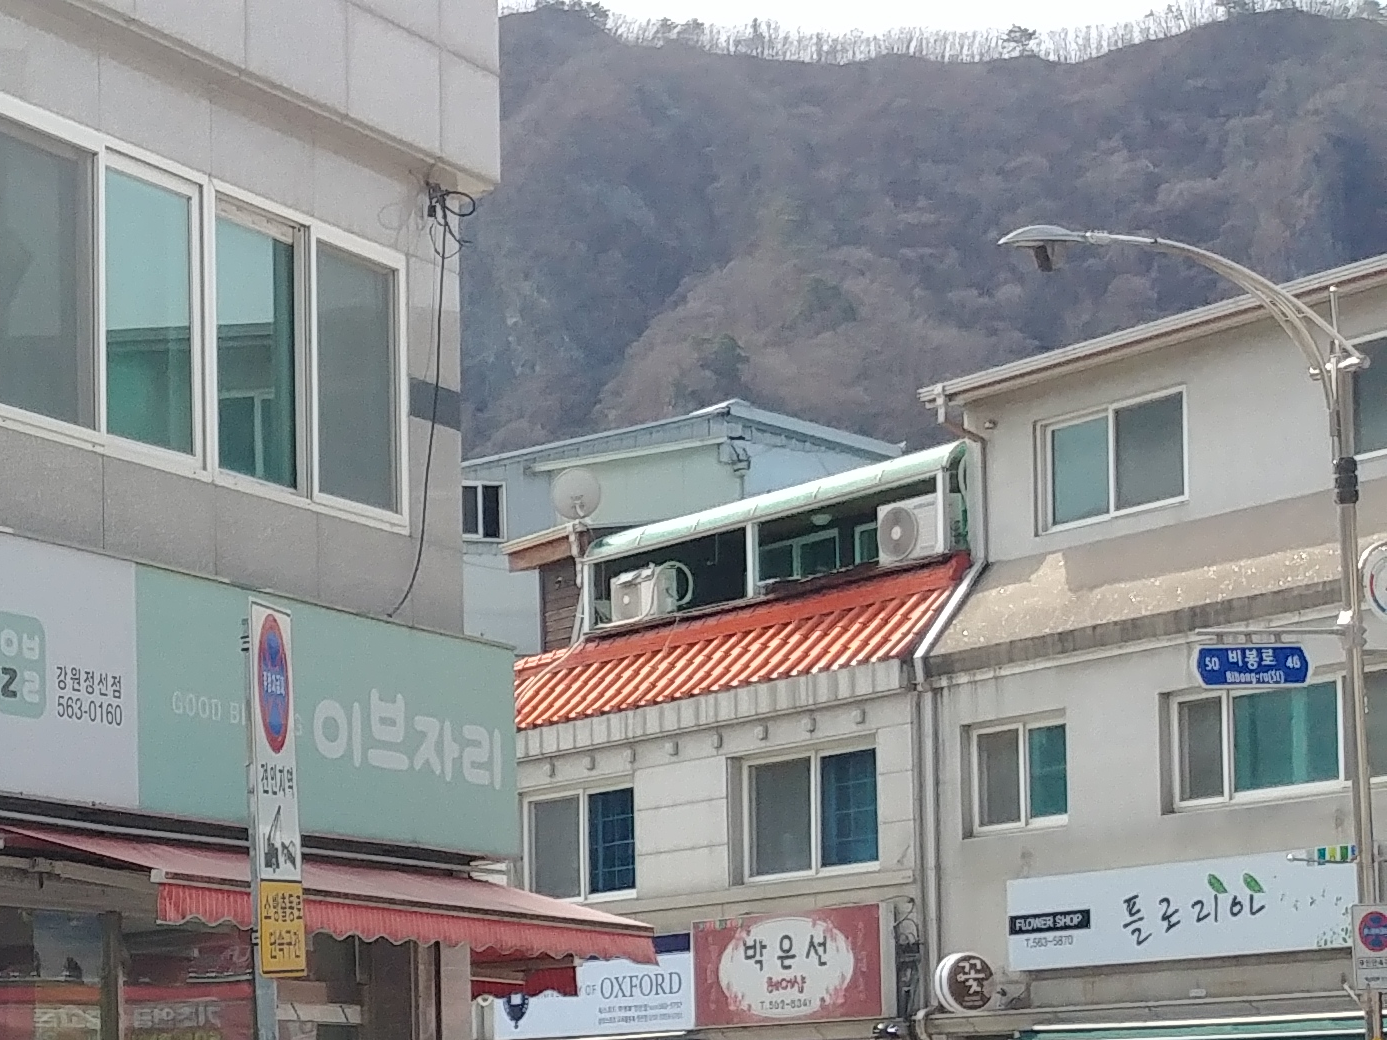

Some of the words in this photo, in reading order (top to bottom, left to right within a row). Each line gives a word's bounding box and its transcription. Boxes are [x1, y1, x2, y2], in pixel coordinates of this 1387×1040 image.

[1205, 657, 1220, 670] 50
[1227, 648, 1277, 669] 비봉로
[56, 666, 122, 699] 강원정선점
[57, 695, 123, 726] 563-0160
[172, 691, 221, 720] GOOD
[314, 688, 501, 790] 이브자리
[261, 762, 294, 798] 견인지역
[1015, 916, 1053, 931] FLOWER
[1054, 913, 1082, 927] SHOP
[600, 972, 682, 1000] OXFORD
